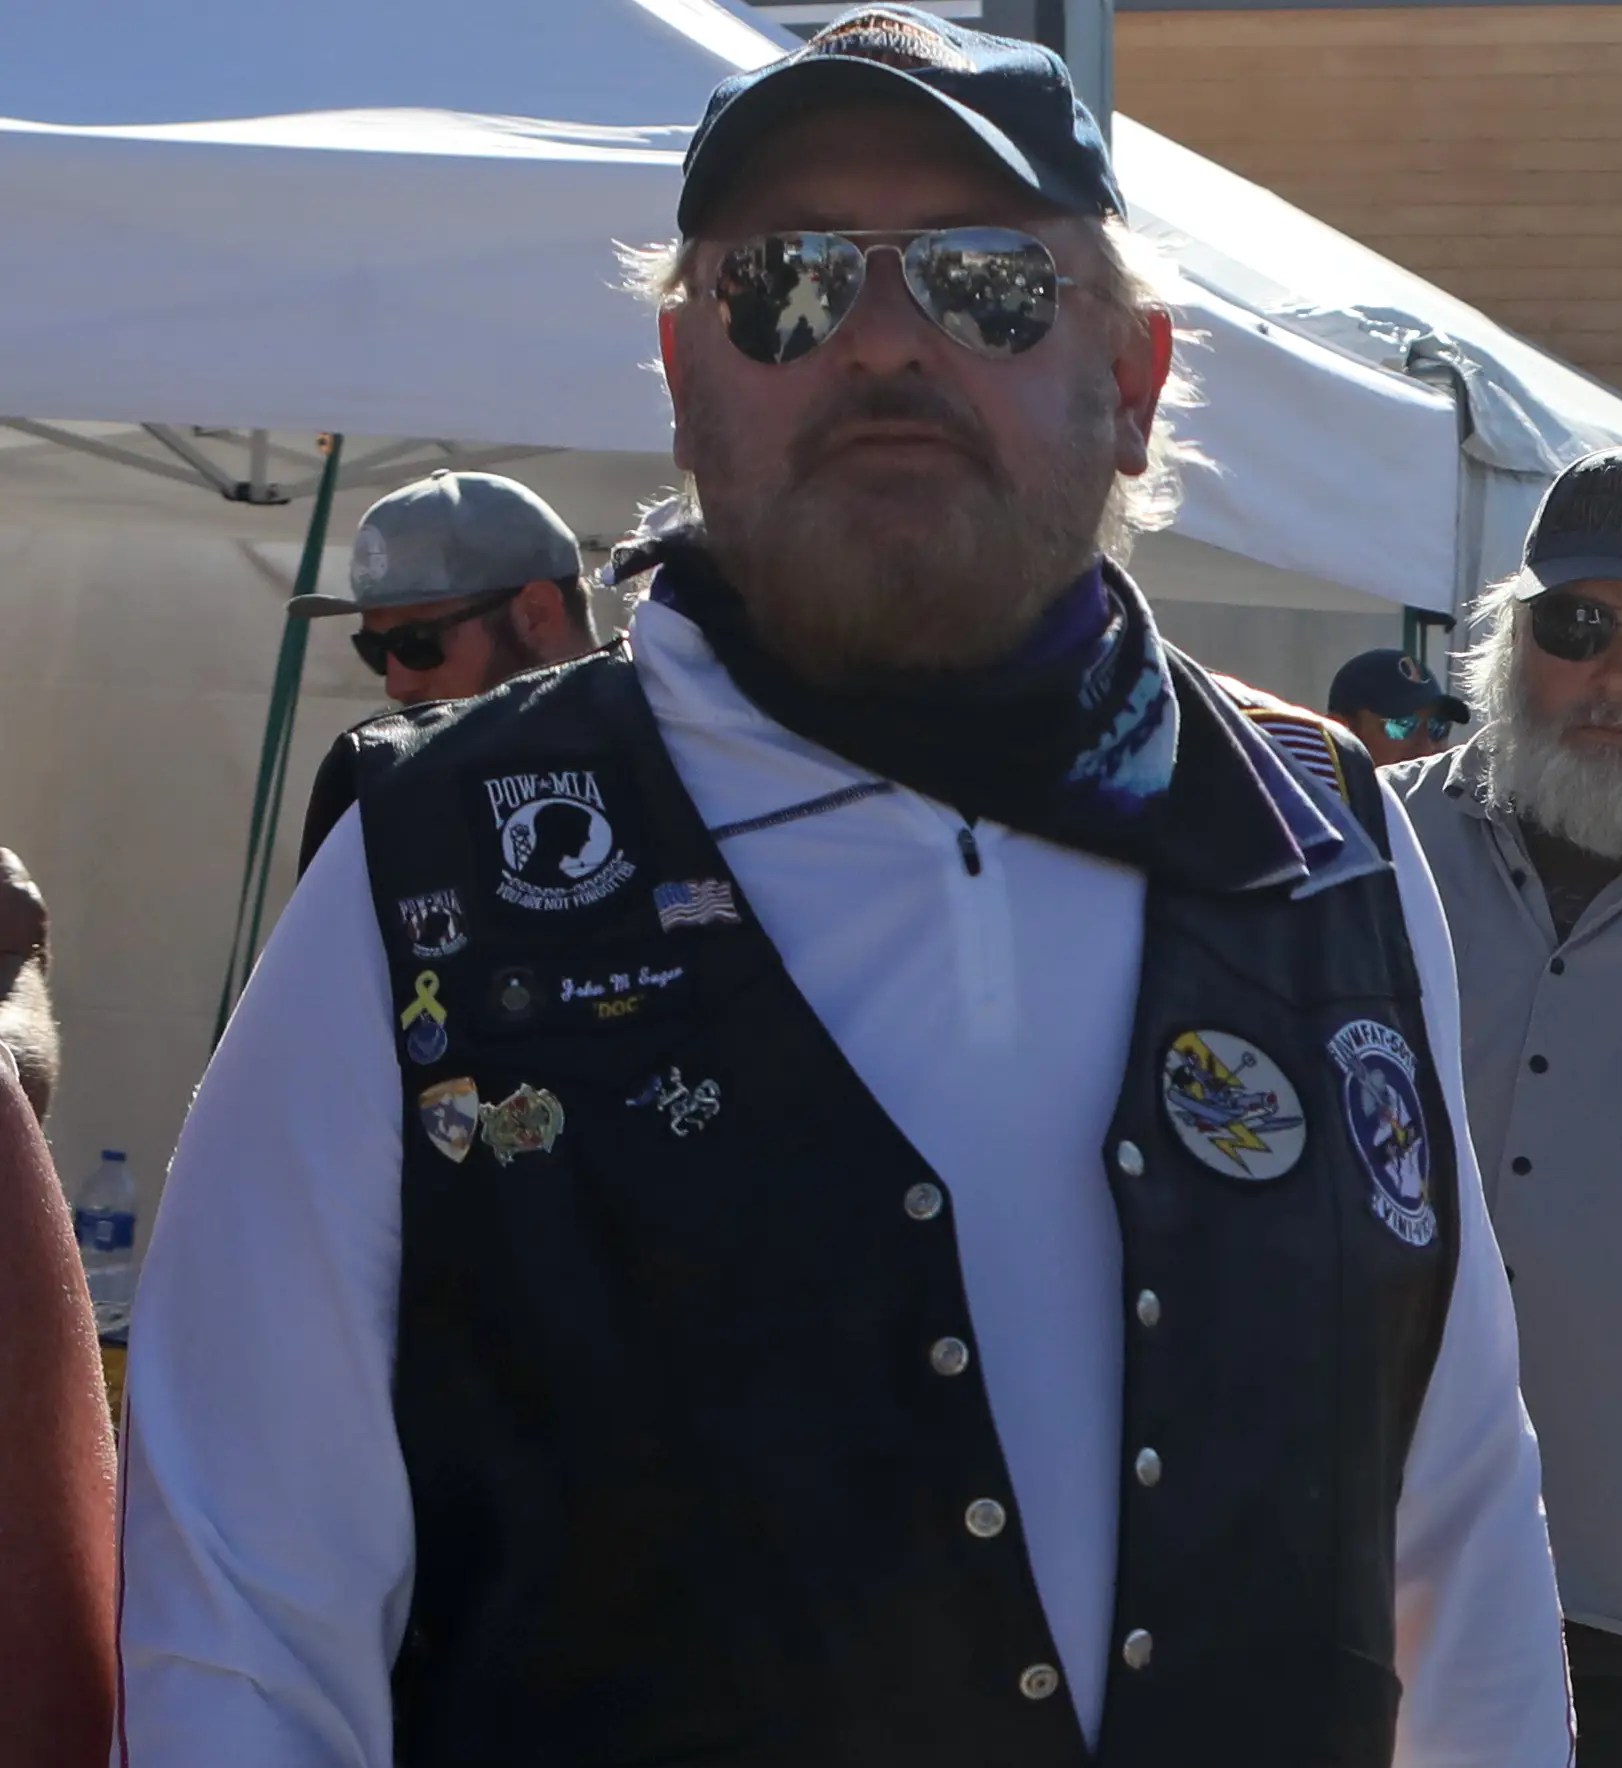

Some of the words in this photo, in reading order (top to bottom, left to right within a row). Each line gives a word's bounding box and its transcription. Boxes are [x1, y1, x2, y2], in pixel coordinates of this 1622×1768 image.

[483, 773, 538, 830] POW
[549, 771, 607, 812] MIA
[609, 973, 631, 992] M
